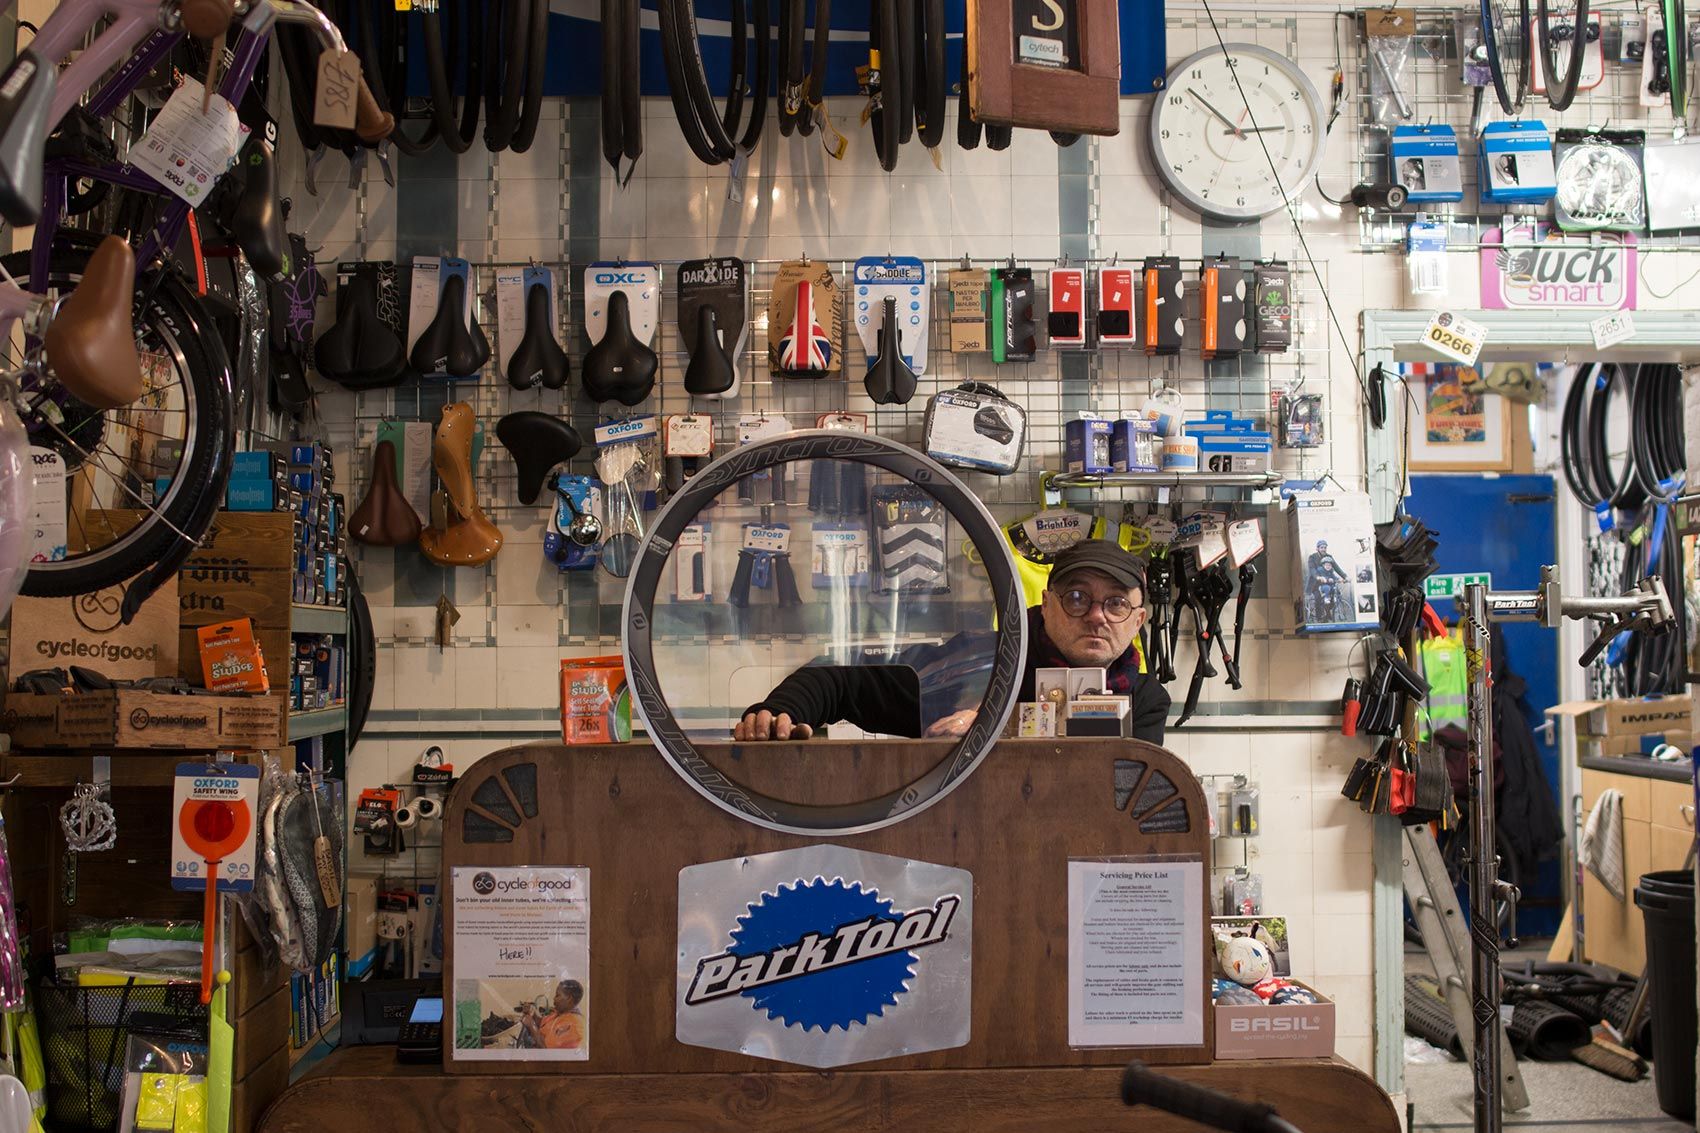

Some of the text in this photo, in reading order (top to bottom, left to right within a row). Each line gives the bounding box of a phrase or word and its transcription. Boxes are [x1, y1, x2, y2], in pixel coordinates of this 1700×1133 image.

[1028, 42, 1060, 54] cytech
[1225, 57, 1238, 67] 12
[1191, 69, 1202, 80] 11
[323, 61, 353, 117] £185
[1169, 95, 1183, 106] 10
[1290, 90, 1300, 101] 2
[1160, 129, 1170, 139] 9
[1302, 124, 1311, 134] 3
[1173, 163, 1184, 174] 8
[1201, 189, 1209, 199] 7
[1271, 186, 1280, 196] 5
[1236, 196, 1245, 207] 6
[1528, 282, 1604, 302] smart
[1258, 305, 1290, 316] GECO
[1599, 316, 1627, 338] 2651
[1431, 326, 1473, 356] 0266
[952, 398, 978, 408] OXFORD
[607, 422, 644, 435] OXFORD
[751, 529, 784, 539] OXFORD
[1177, 522, 1201, 535] FORD
[823, 533, 856, 542] OXFORD
[1430, 577, 1447, 586] Fire
[1430, 585, 1447, 595] exit
[36, 639, 158, 662] cycleofgood
[211, 662, 256, 680] SLUDGE
[150, 714, 207, 727] cycleofgood
[1622, 710, 1691, 723] IMPAC
[578, 719, 600, 731] 26x
[194, 778, 239, 788] OXFORD
[1100, 872, 1133, 880] Servicing
[497, 877, 572, 893] cycleofgood
[499, 946, 533, 961] HERE!!
[686, 895, 965, 1006] ParkTool
[1230, 1017, 1320, 1032] BASIL
